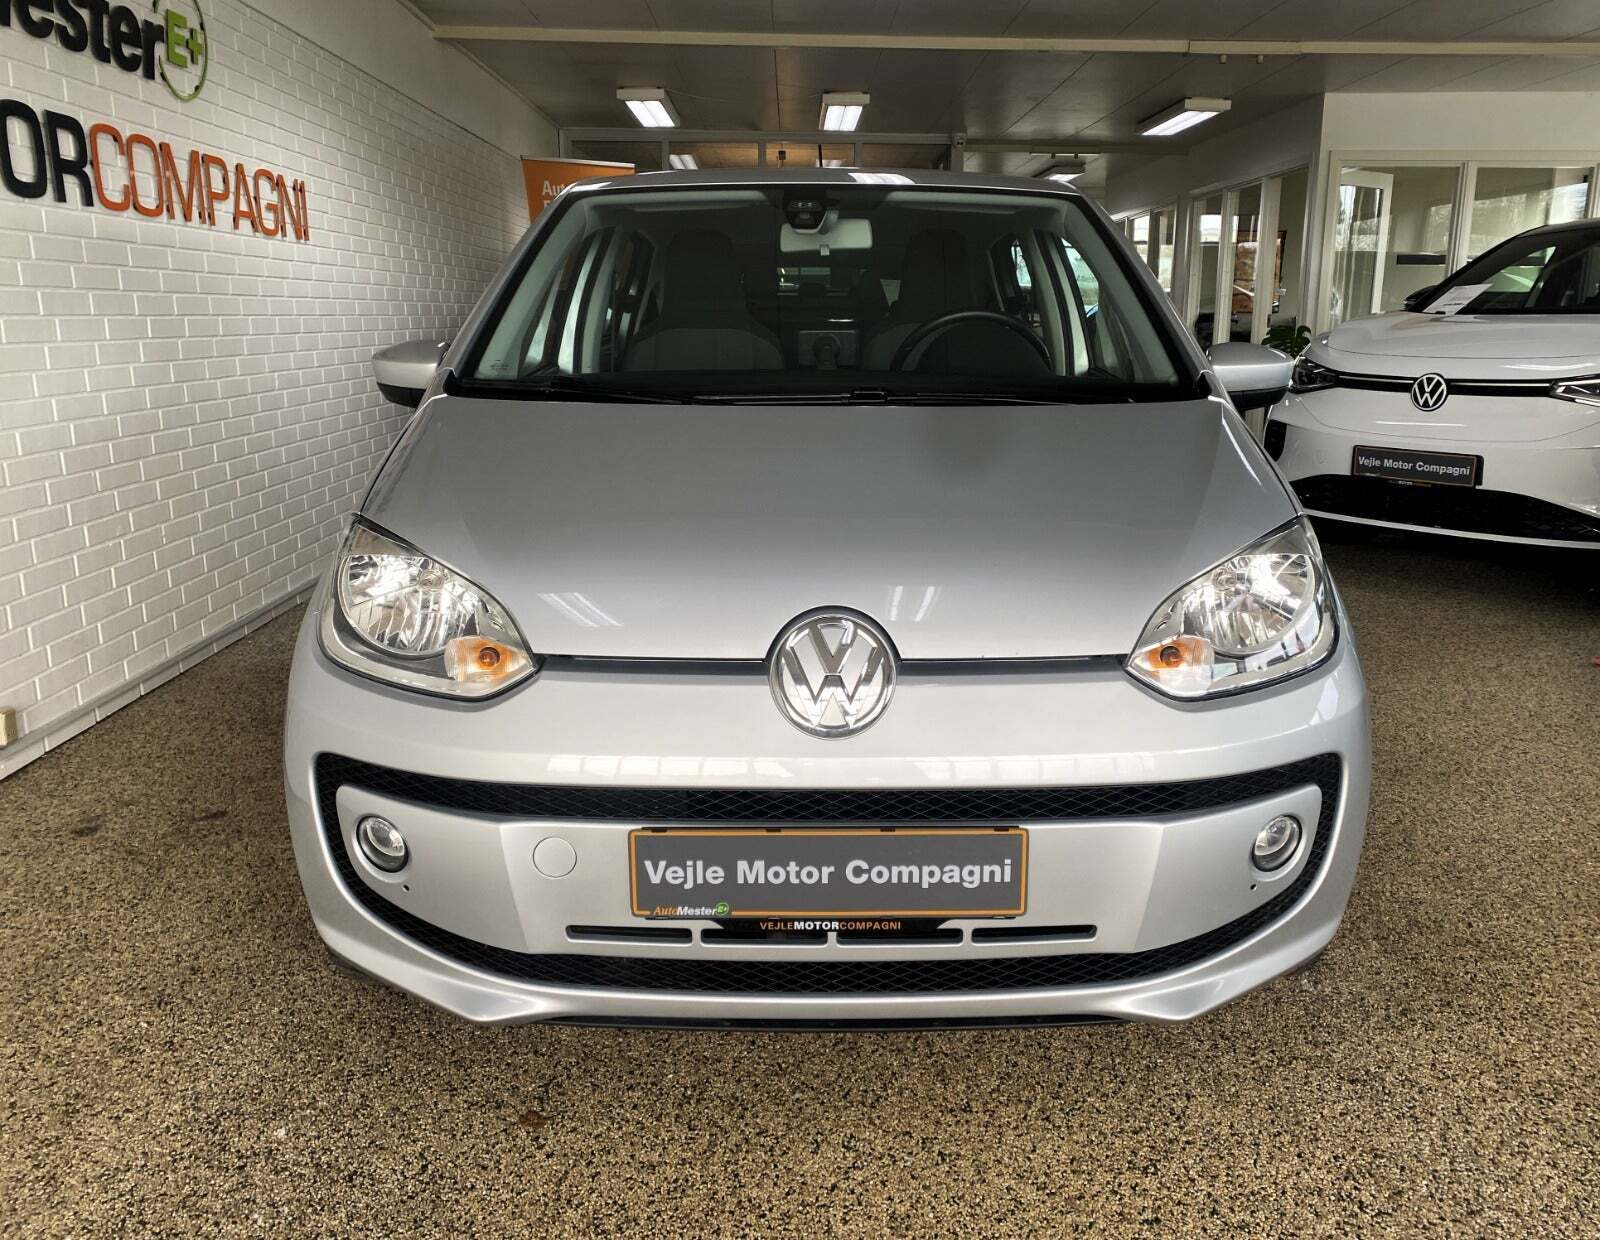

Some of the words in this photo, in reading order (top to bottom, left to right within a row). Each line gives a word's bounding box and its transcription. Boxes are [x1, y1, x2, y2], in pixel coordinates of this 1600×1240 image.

[1359, 455, 1381, 468] Vejle
[1383, 458, 1413, 470] Motor
[1416, 461, 1471, 476] Compagni
[776, 615, 892, 735] VW
[644, 860, 725, 889] Vejle
[736, 860, 835, 885] Motor
[845, 859, 1012, 889] Compagni
